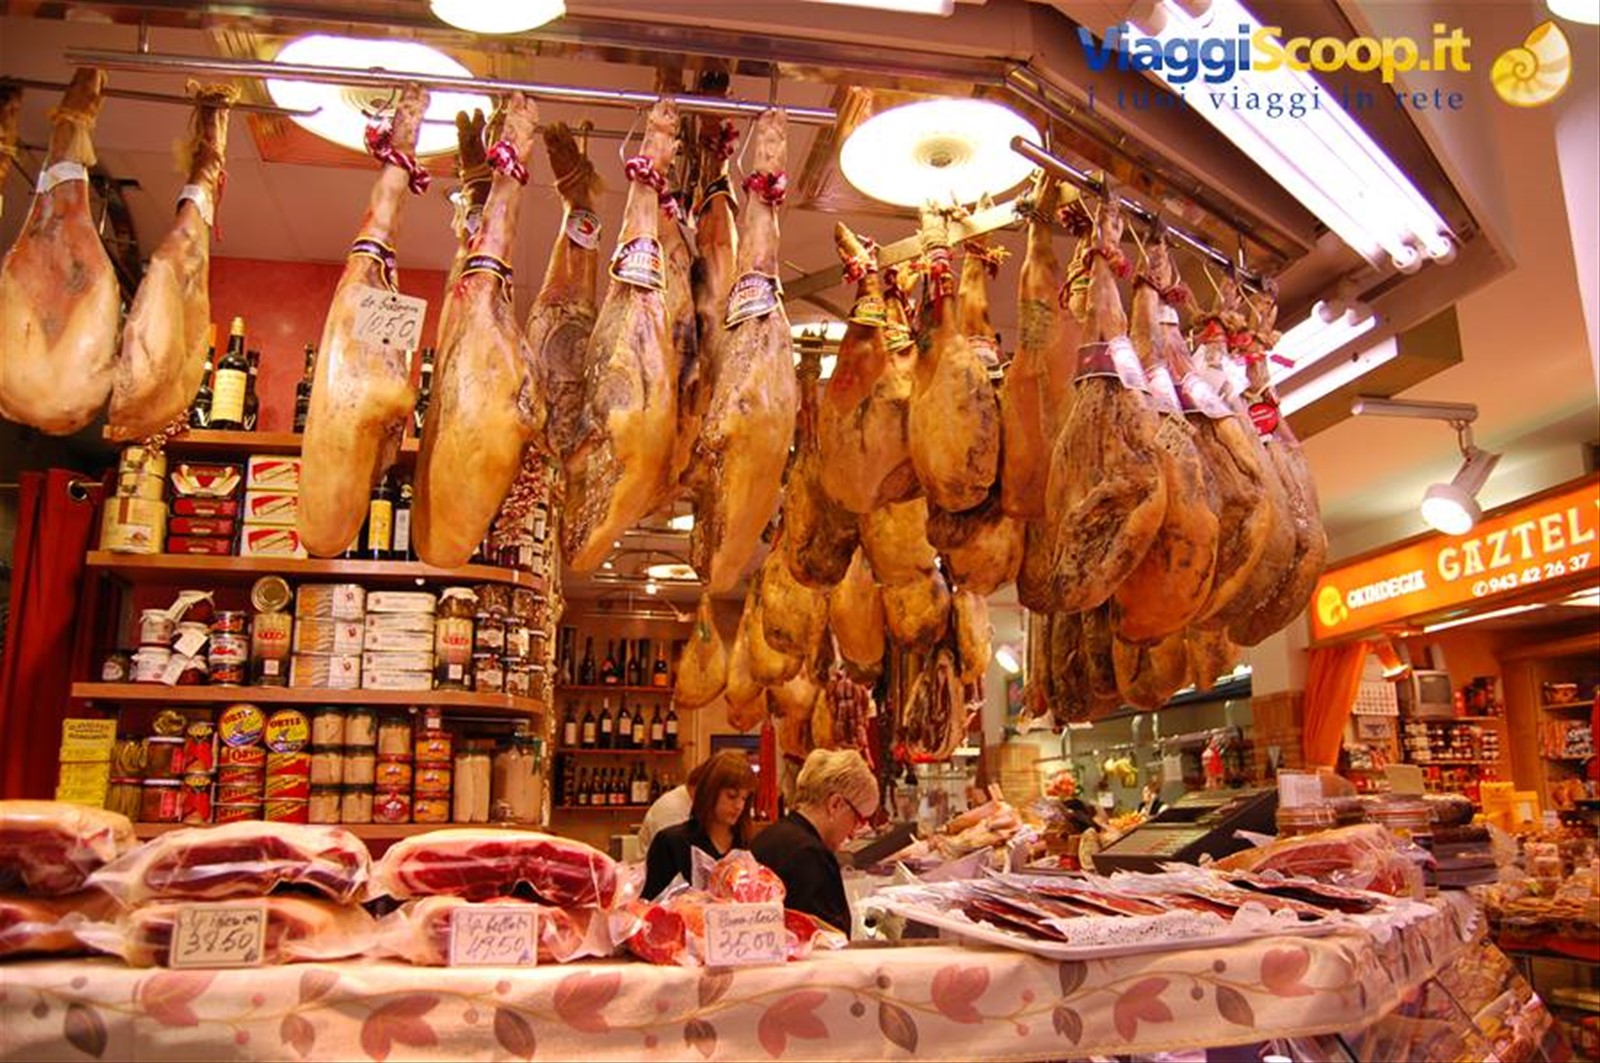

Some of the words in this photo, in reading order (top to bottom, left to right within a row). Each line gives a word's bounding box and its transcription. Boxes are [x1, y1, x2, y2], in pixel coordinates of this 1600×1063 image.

[1520, 567, 1542, 586] 42
[1544, 560, 1566, 578] 26
[1568, 552, 1592, 572] 37
